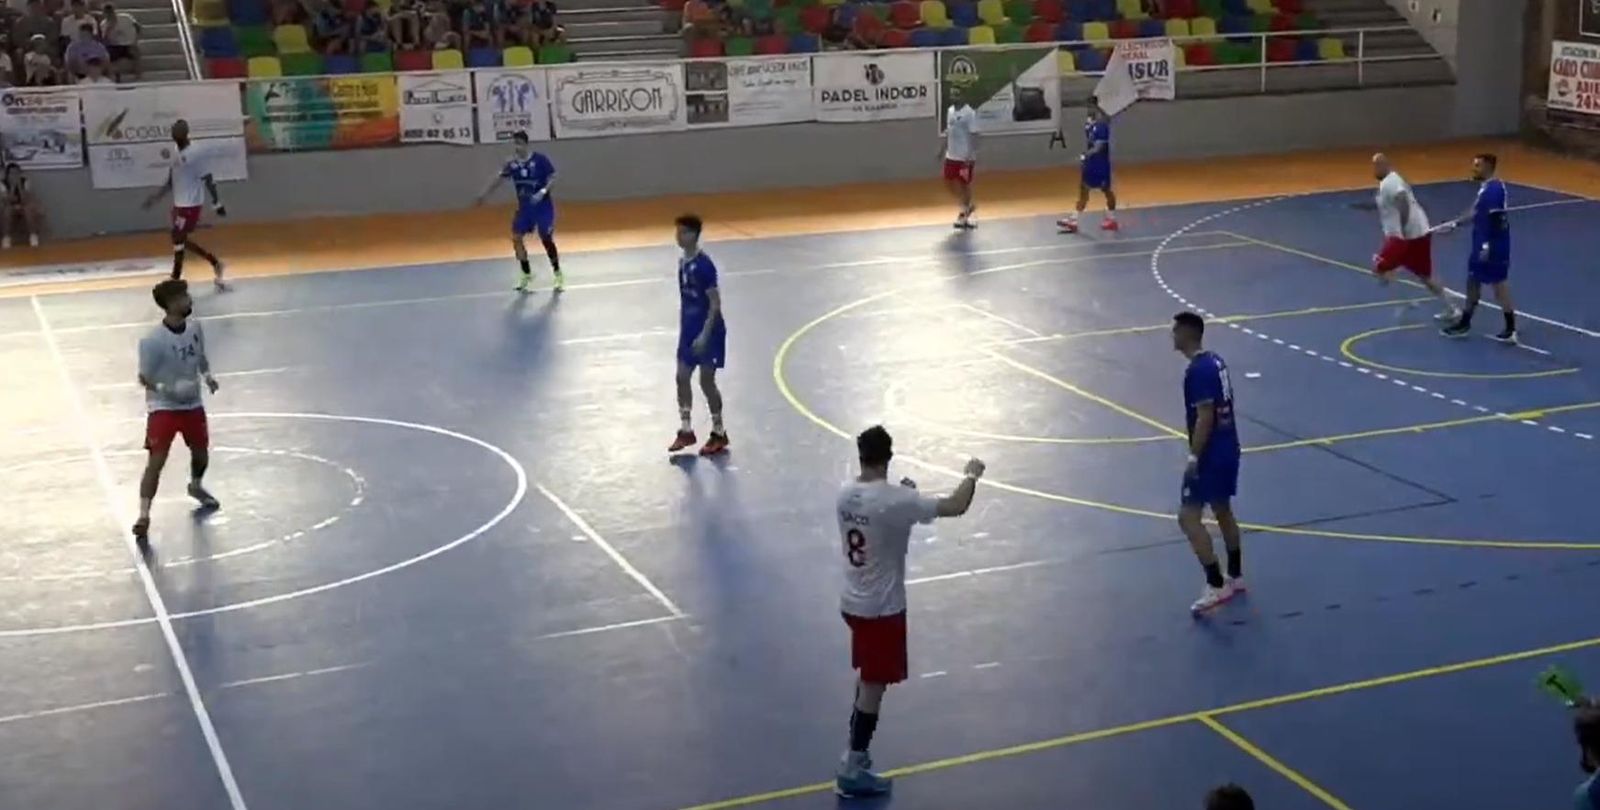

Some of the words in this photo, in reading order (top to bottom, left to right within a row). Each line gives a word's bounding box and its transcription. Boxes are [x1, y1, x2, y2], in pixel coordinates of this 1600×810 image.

[571, 86, 663, 114] GARRISON
[821, 88, 869, 103] PADEL
[875, 85, 928, 101] INDOOR
[847, 527, 866, 568] 8
